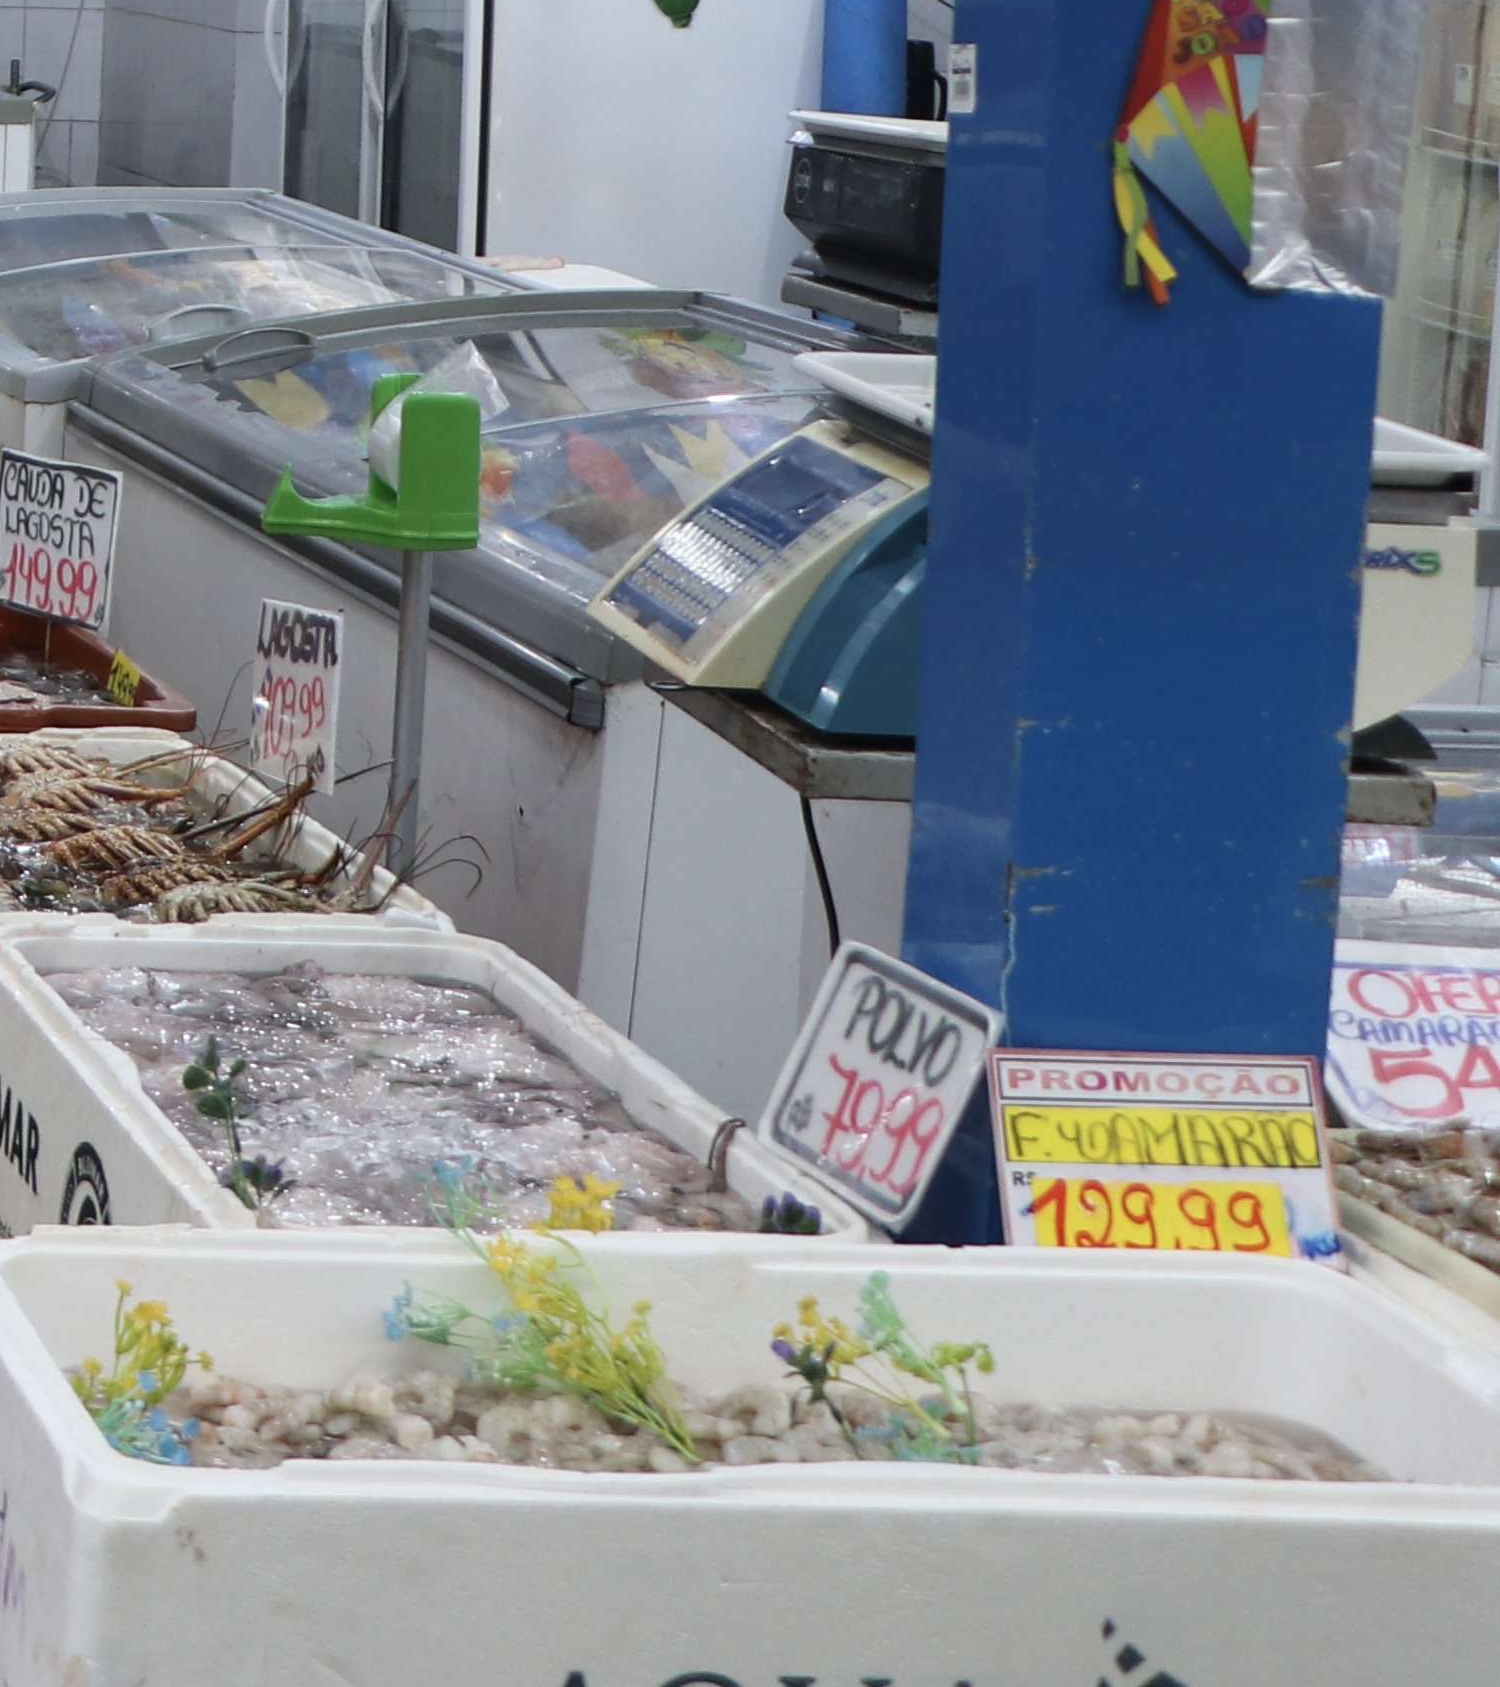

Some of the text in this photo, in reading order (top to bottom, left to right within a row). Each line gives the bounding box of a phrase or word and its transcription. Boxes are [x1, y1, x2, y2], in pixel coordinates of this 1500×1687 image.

[3, 462, 108, 519] CAUDA DE
[5, 505, 95, 561] LAGOSTA
[256, 600, 339, 670] LAGOSTA
[844, 975, 962, 1088] POLVO
[1007, 1067, 1300, 1098] PROMOÇÃO
